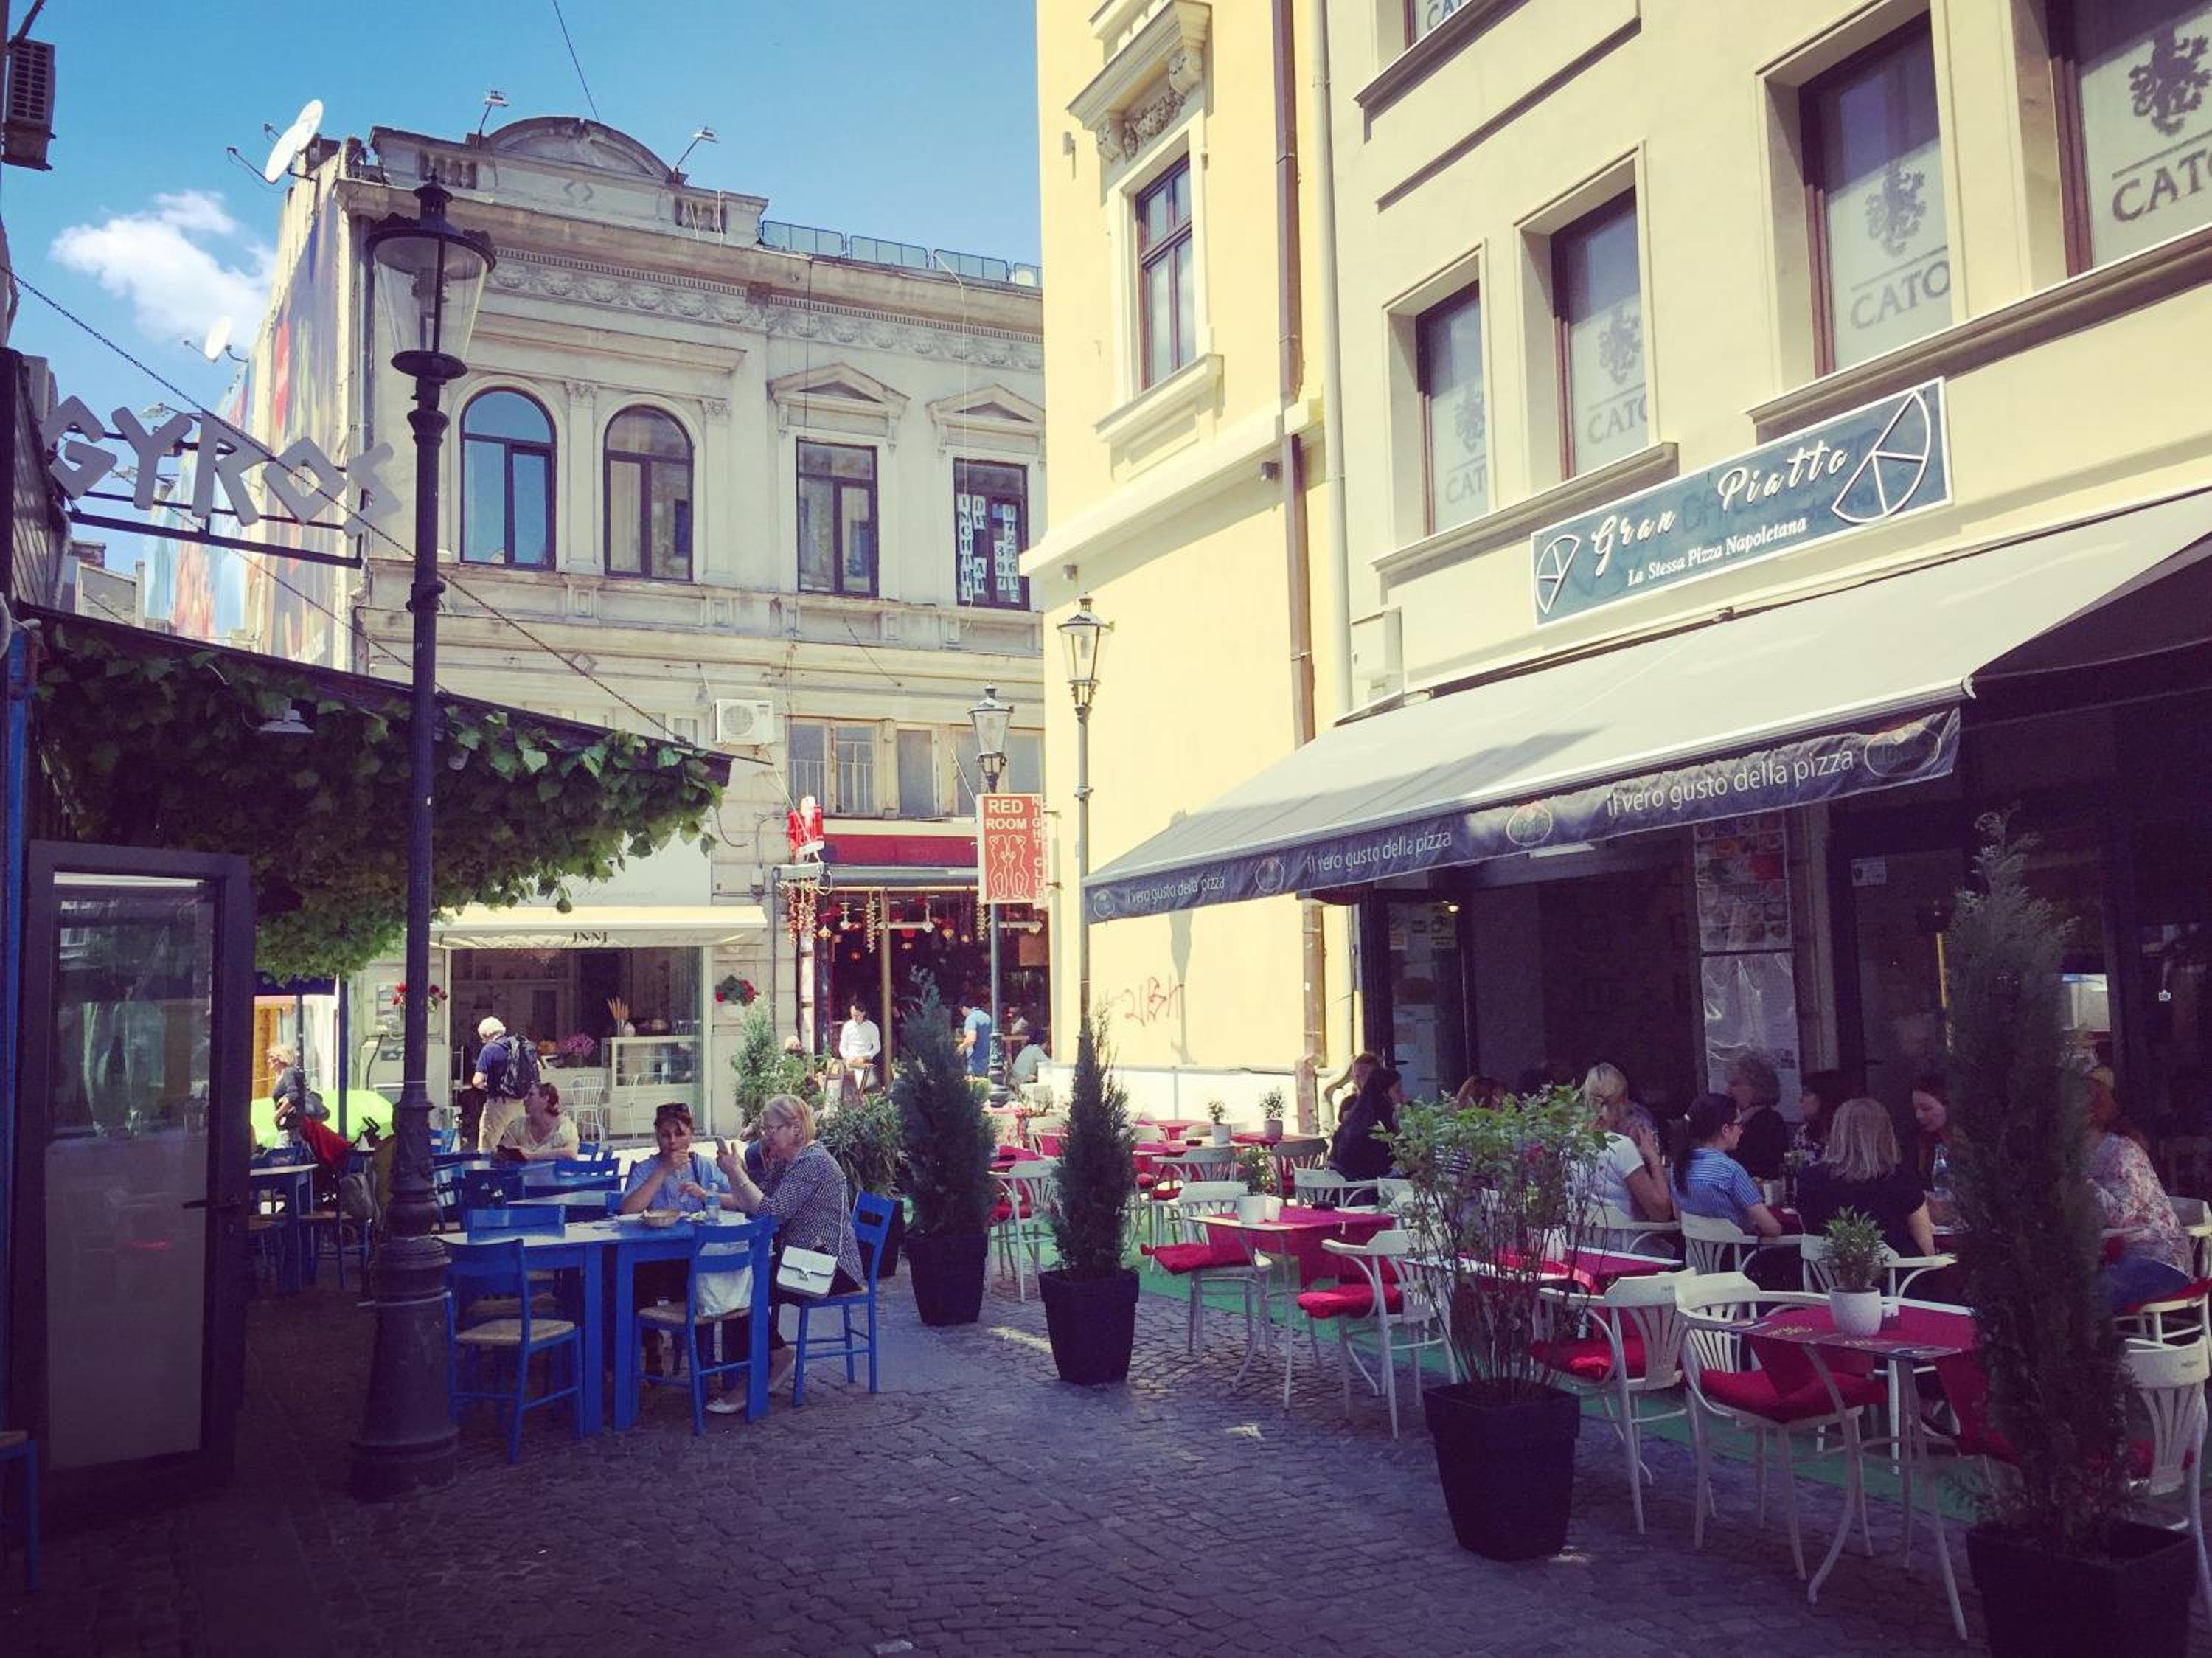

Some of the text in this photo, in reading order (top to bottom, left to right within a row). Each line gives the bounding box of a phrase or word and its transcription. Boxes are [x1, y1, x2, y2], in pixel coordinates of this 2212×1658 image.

[2112, 147, 2212, 222] CAT
[42, 395, 403, 540] GYROS
[1591, 510, 1675, 577] Gran
[1718, 440, 1848, 510] Piatto
[1628, 518, 1806, 586] La Stessa Pizza Napoletana
[988, 800, 1023, 814] RED
[1622, 790, 1664, 812] vero
[1670, 777, 1727, 811] gusto
[1734, 760, 1787, 791] della
[1794, 751, 1853, 788] pizza
[986, 818, 1027, 830] ROOM
[1318, 854, 1342, 872] vero
[1346, 846, 1379, 873] gusto
[1382, 836, 1412, 859] della
[1416, 831, 1451, 857] pizza
[1152, 884, 1176, 905] gusto
